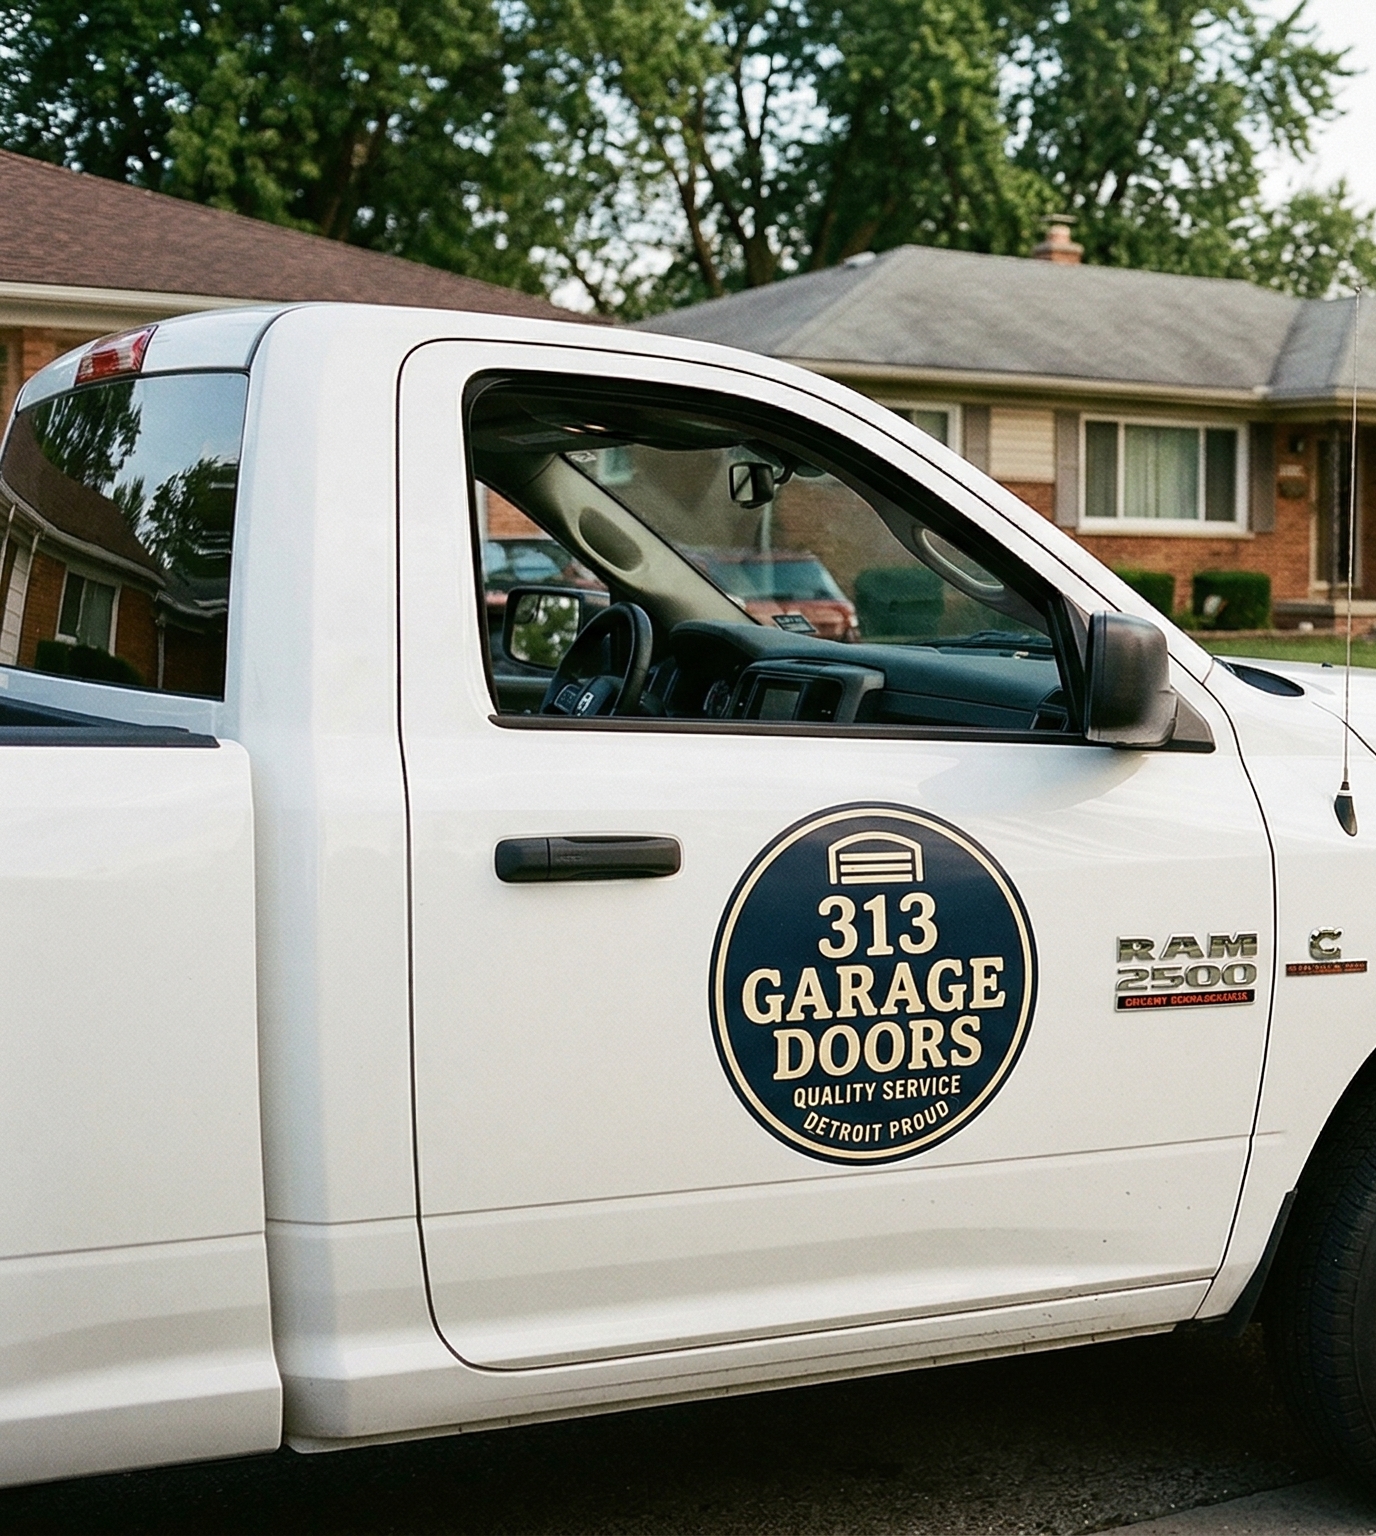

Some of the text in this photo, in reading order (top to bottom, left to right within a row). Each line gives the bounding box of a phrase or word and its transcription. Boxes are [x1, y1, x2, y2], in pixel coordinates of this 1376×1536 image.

[818, 892, 938, 959] 313
[1117, 931, 1258, 962] RAM
[742, 957, 1006, 1024] GARAGE
[1115, 961, 1257, 991] 2500
[773, 1016, 982, 1080] DOORS
[793, 1075, 961, 1109] QUALITY SERVICE
[803, 1100, 950, 1142] DETROIT PROUD
